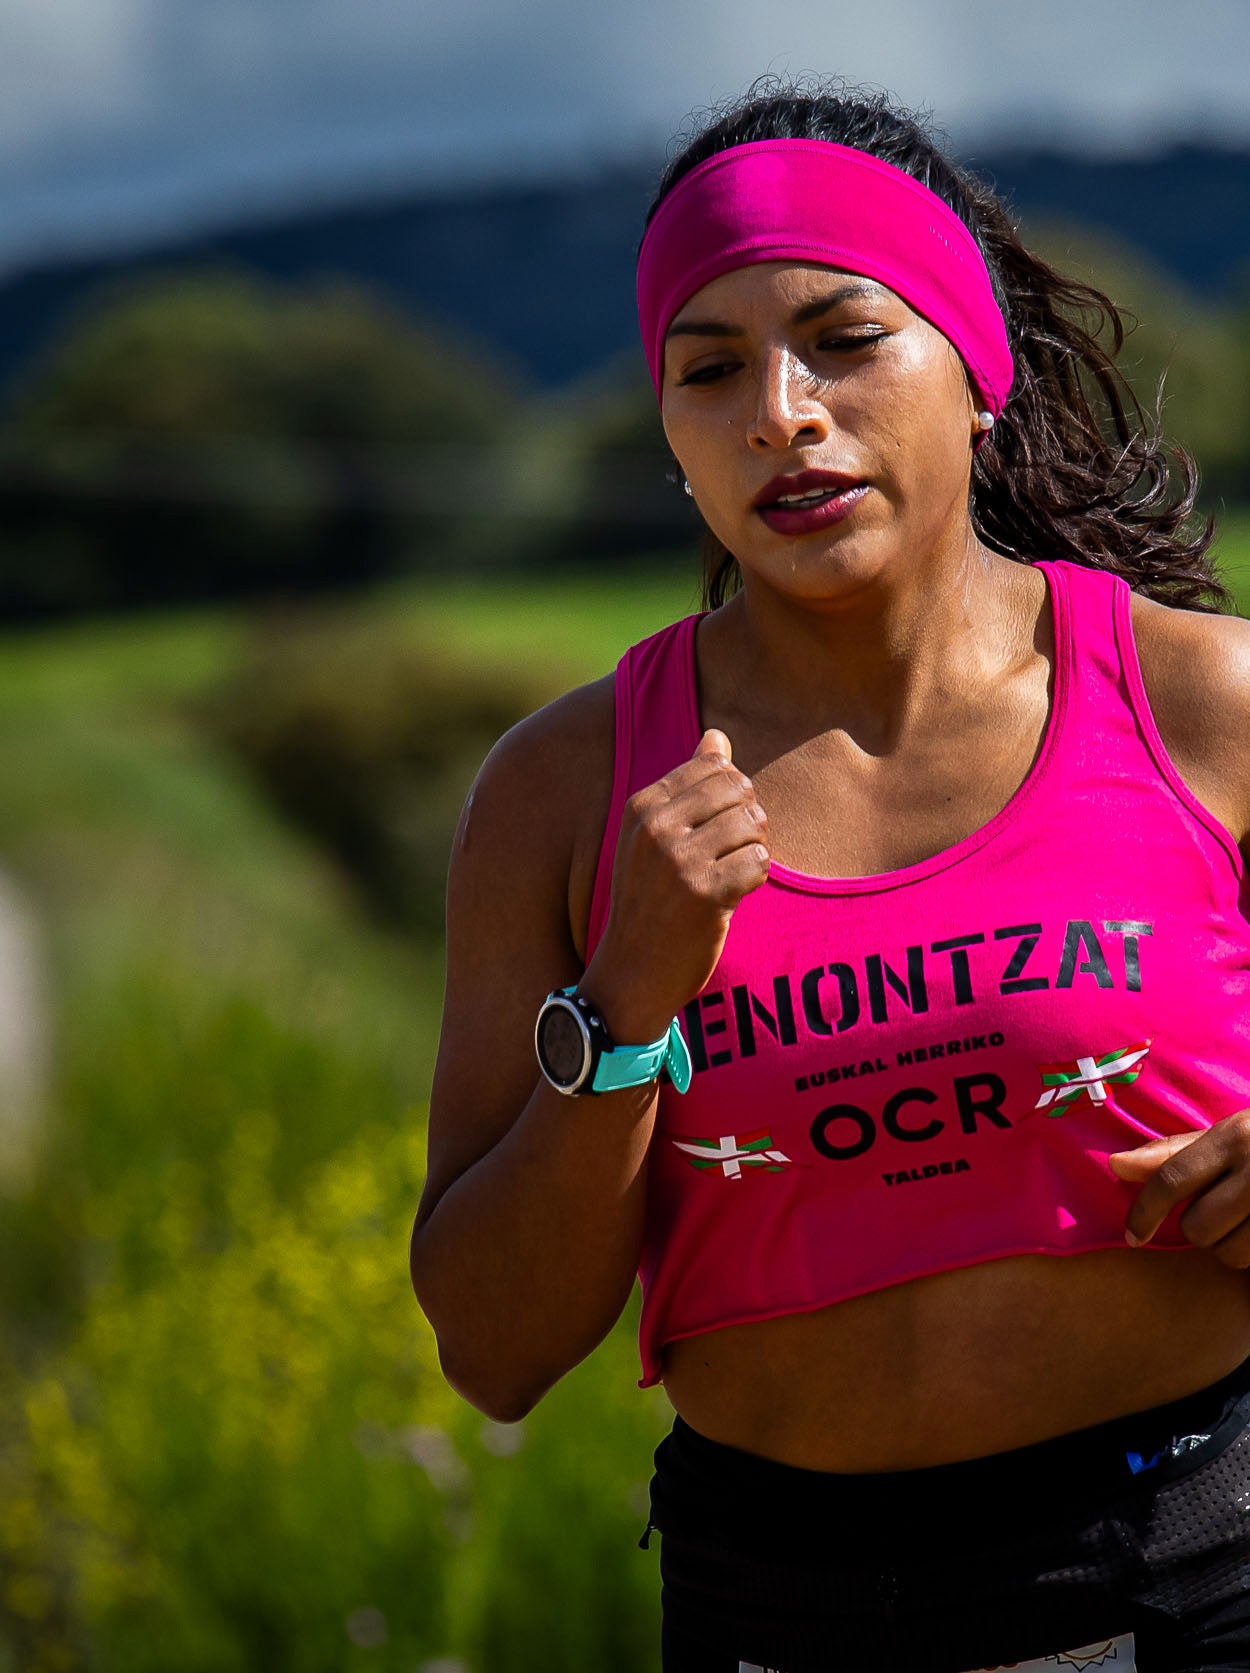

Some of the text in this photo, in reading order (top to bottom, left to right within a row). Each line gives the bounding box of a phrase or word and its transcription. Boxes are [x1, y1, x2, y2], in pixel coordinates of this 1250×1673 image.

[662, 920, 1154, 1083] ENONTZAT
[794, 1032, 1005, 1092] EUSKAL HERRIKO
[809, 1072, 1012, 1161] OCR
[881, 1159, 971, 1186] TALDEA
